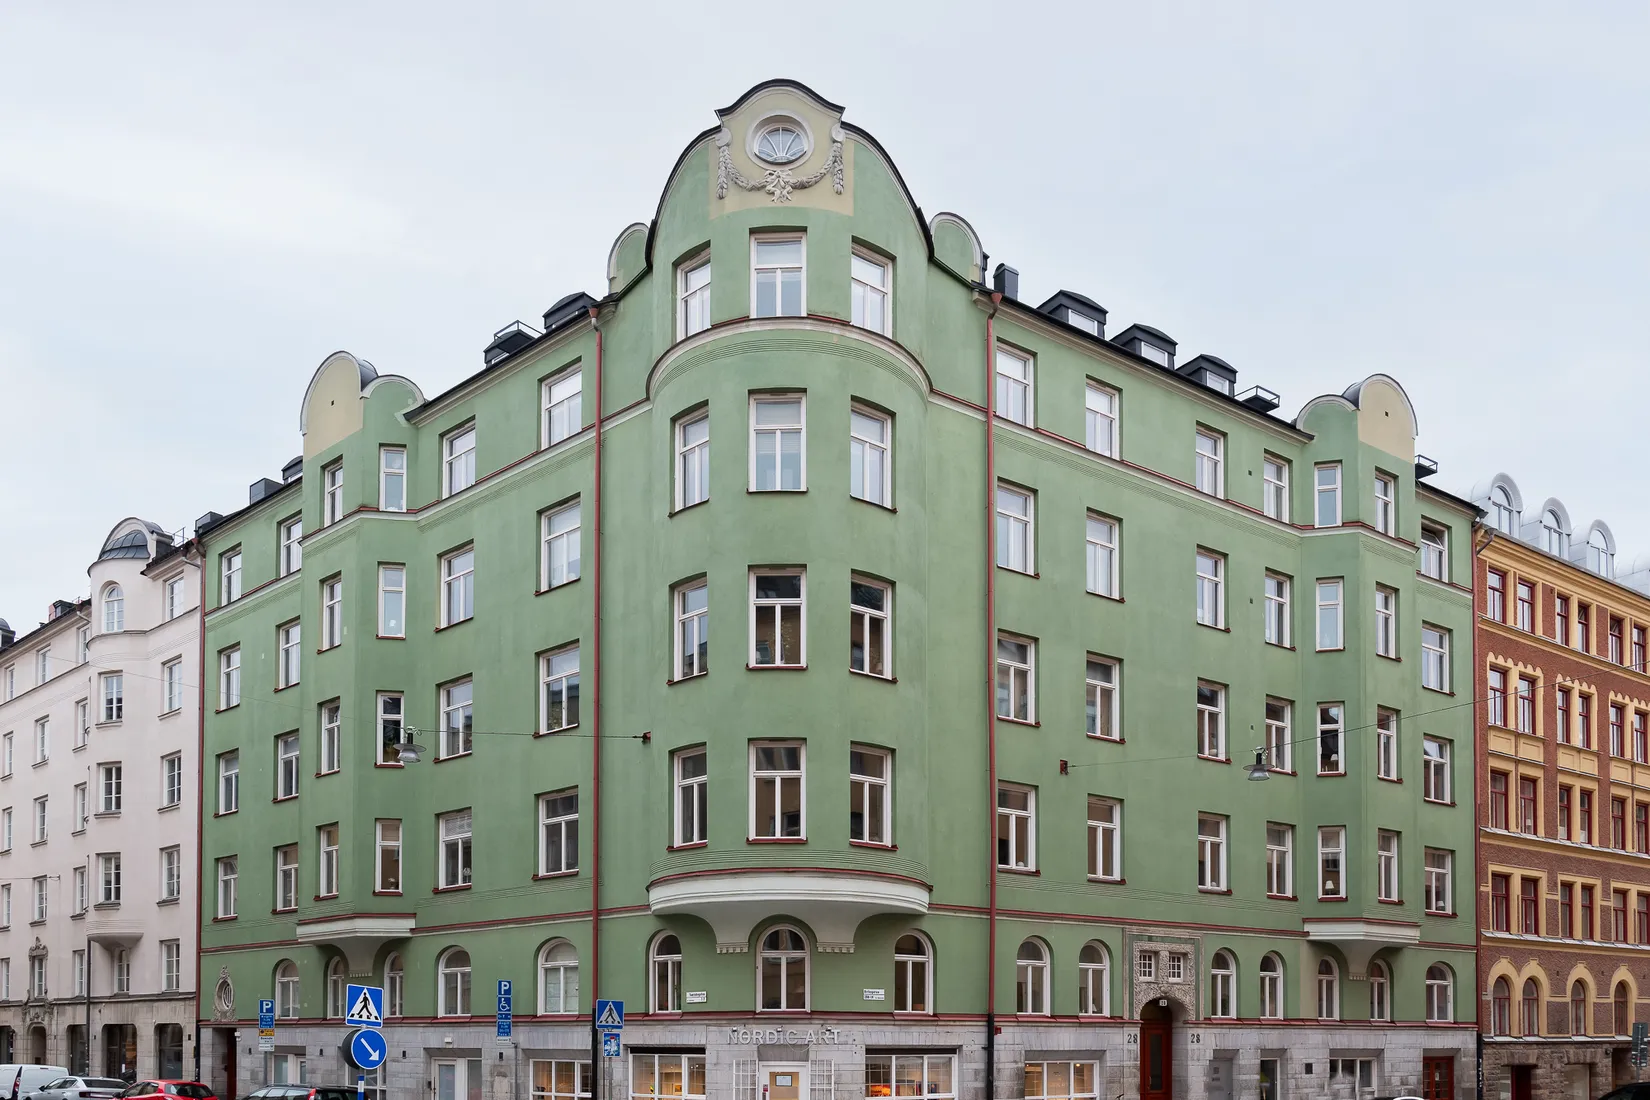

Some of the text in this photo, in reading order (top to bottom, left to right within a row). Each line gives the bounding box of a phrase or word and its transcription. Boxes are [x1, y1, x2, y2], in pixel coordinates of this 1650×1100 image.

[501, 981, 510, 995] P
[263, 1001, 272, 1013] P
[727, 1029, 842, 1045] NORDIC ART
[1127, 1033, 1138, 1044] 28
[1190, 1033, 1201, 1044] 28
